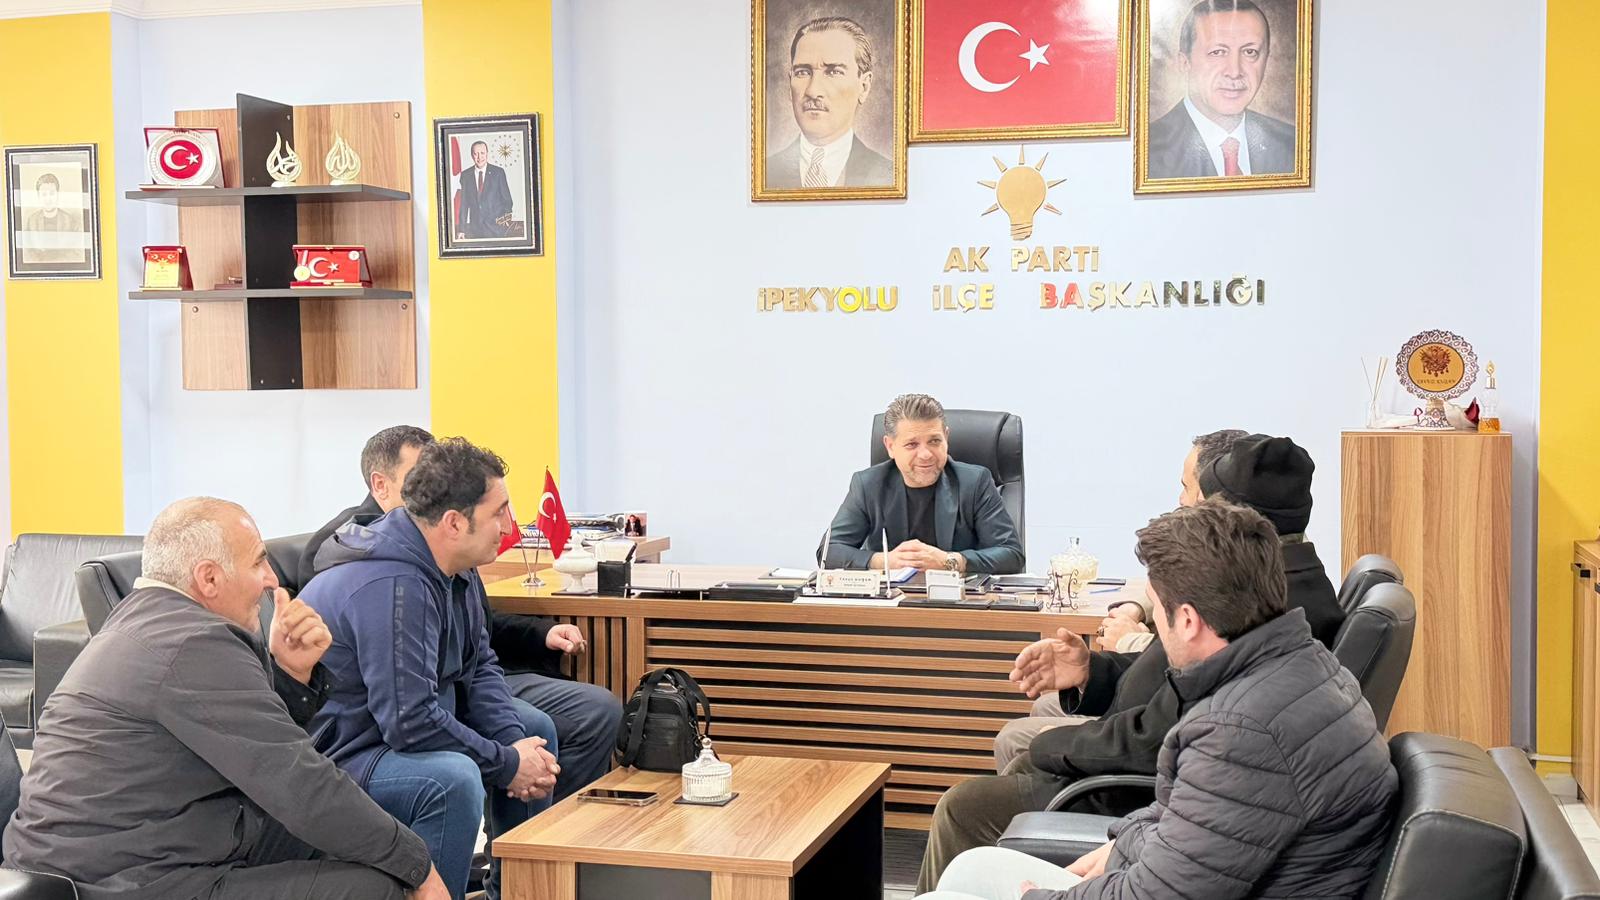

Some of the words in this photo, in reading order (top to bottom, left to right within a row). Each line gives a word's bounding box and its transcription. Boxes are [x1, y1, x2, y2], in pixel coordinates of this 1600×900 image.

[943, 246, 990, 272] AK
[1010, 246, 1100, 272] PARTİ
[757, 286, 899, 313] İPEKYOLU
[932, 283, 994, 313] İLÇE
[1040, 272, 1265, 312] BAŞKANLIĞI
